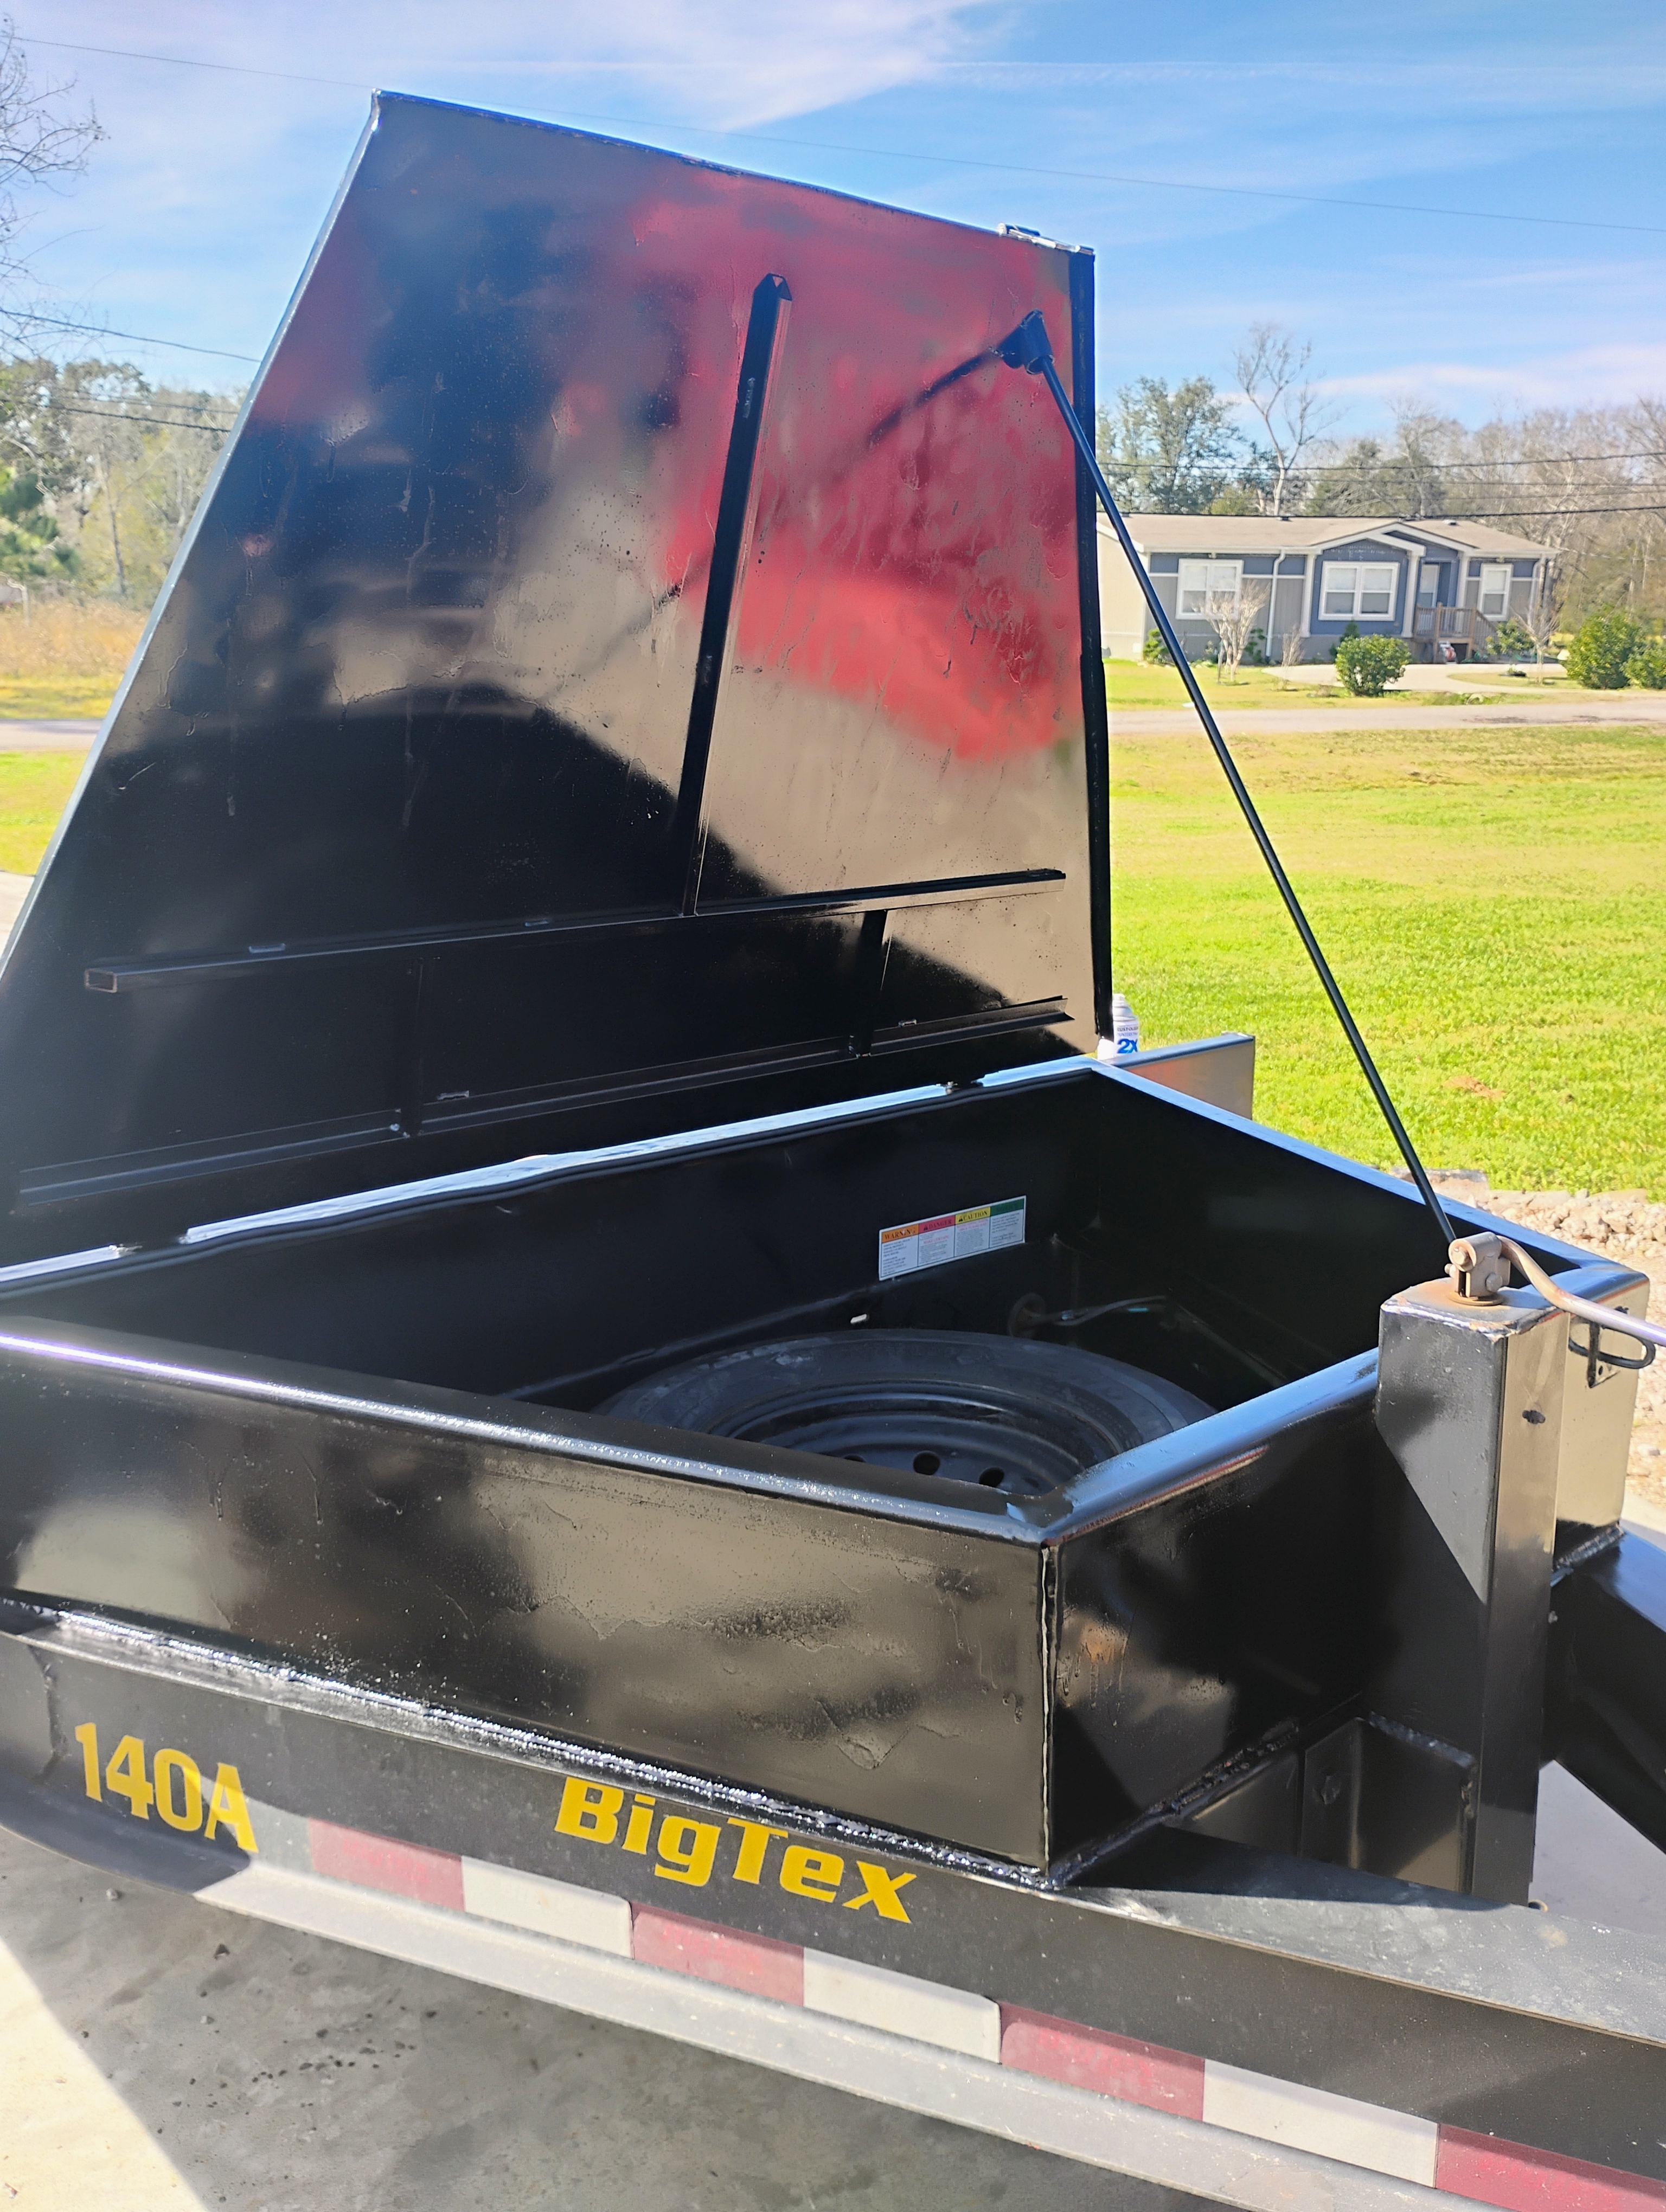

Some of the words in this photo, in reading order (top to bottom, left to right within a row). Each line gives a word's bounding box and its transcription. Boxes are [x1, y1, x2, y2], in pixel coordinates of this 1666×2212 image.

[1117, 1039, 1138, 1053] 2X
[963, 1210, 988, 1220] CAUTION
[928, 1219, 952, 1231] DANGER
[885, 1227, 915, 1240] WARNING
[78, 1724, 256, 1851] 140A
[555, 1777, 917, 1922] BigTex
